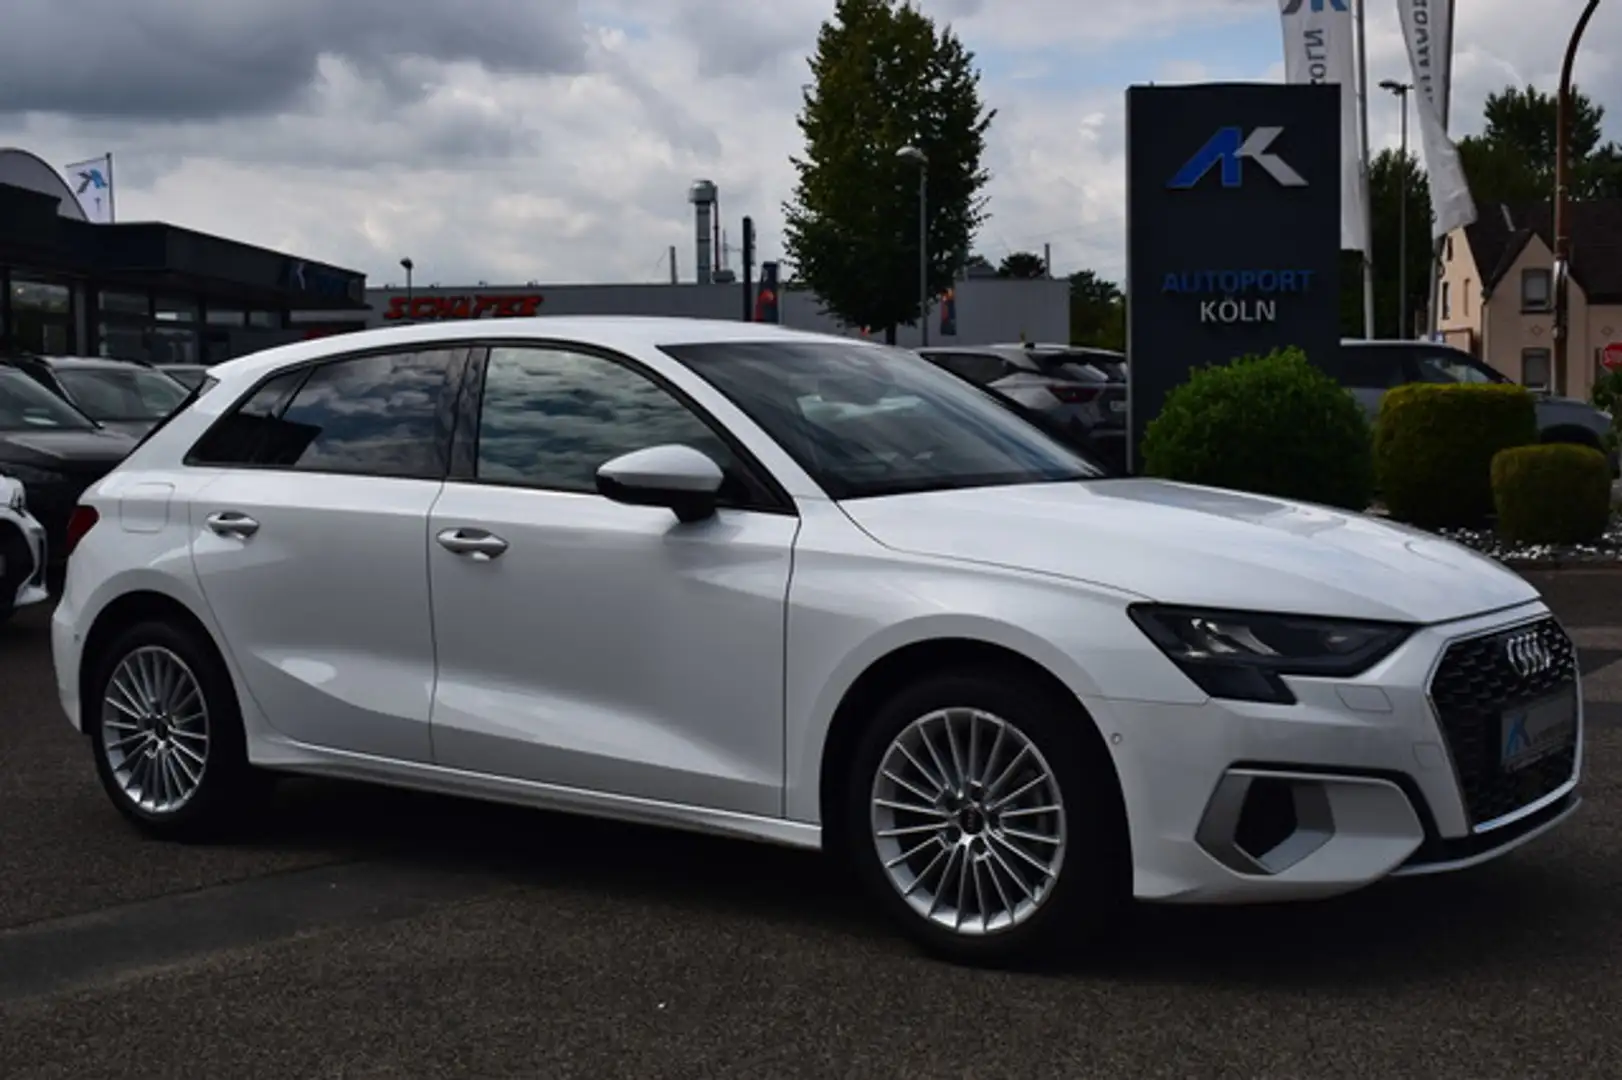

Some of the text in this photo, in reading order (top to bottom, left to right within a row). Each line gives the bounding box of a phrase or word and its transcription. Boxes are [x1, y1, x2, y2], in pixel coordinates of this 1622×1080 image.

[1166, 126, 1310, 188] AK
[1161, 269, 1315, 293] AUTOPORT
[1199, 296, 1276, 323] KÖLN
